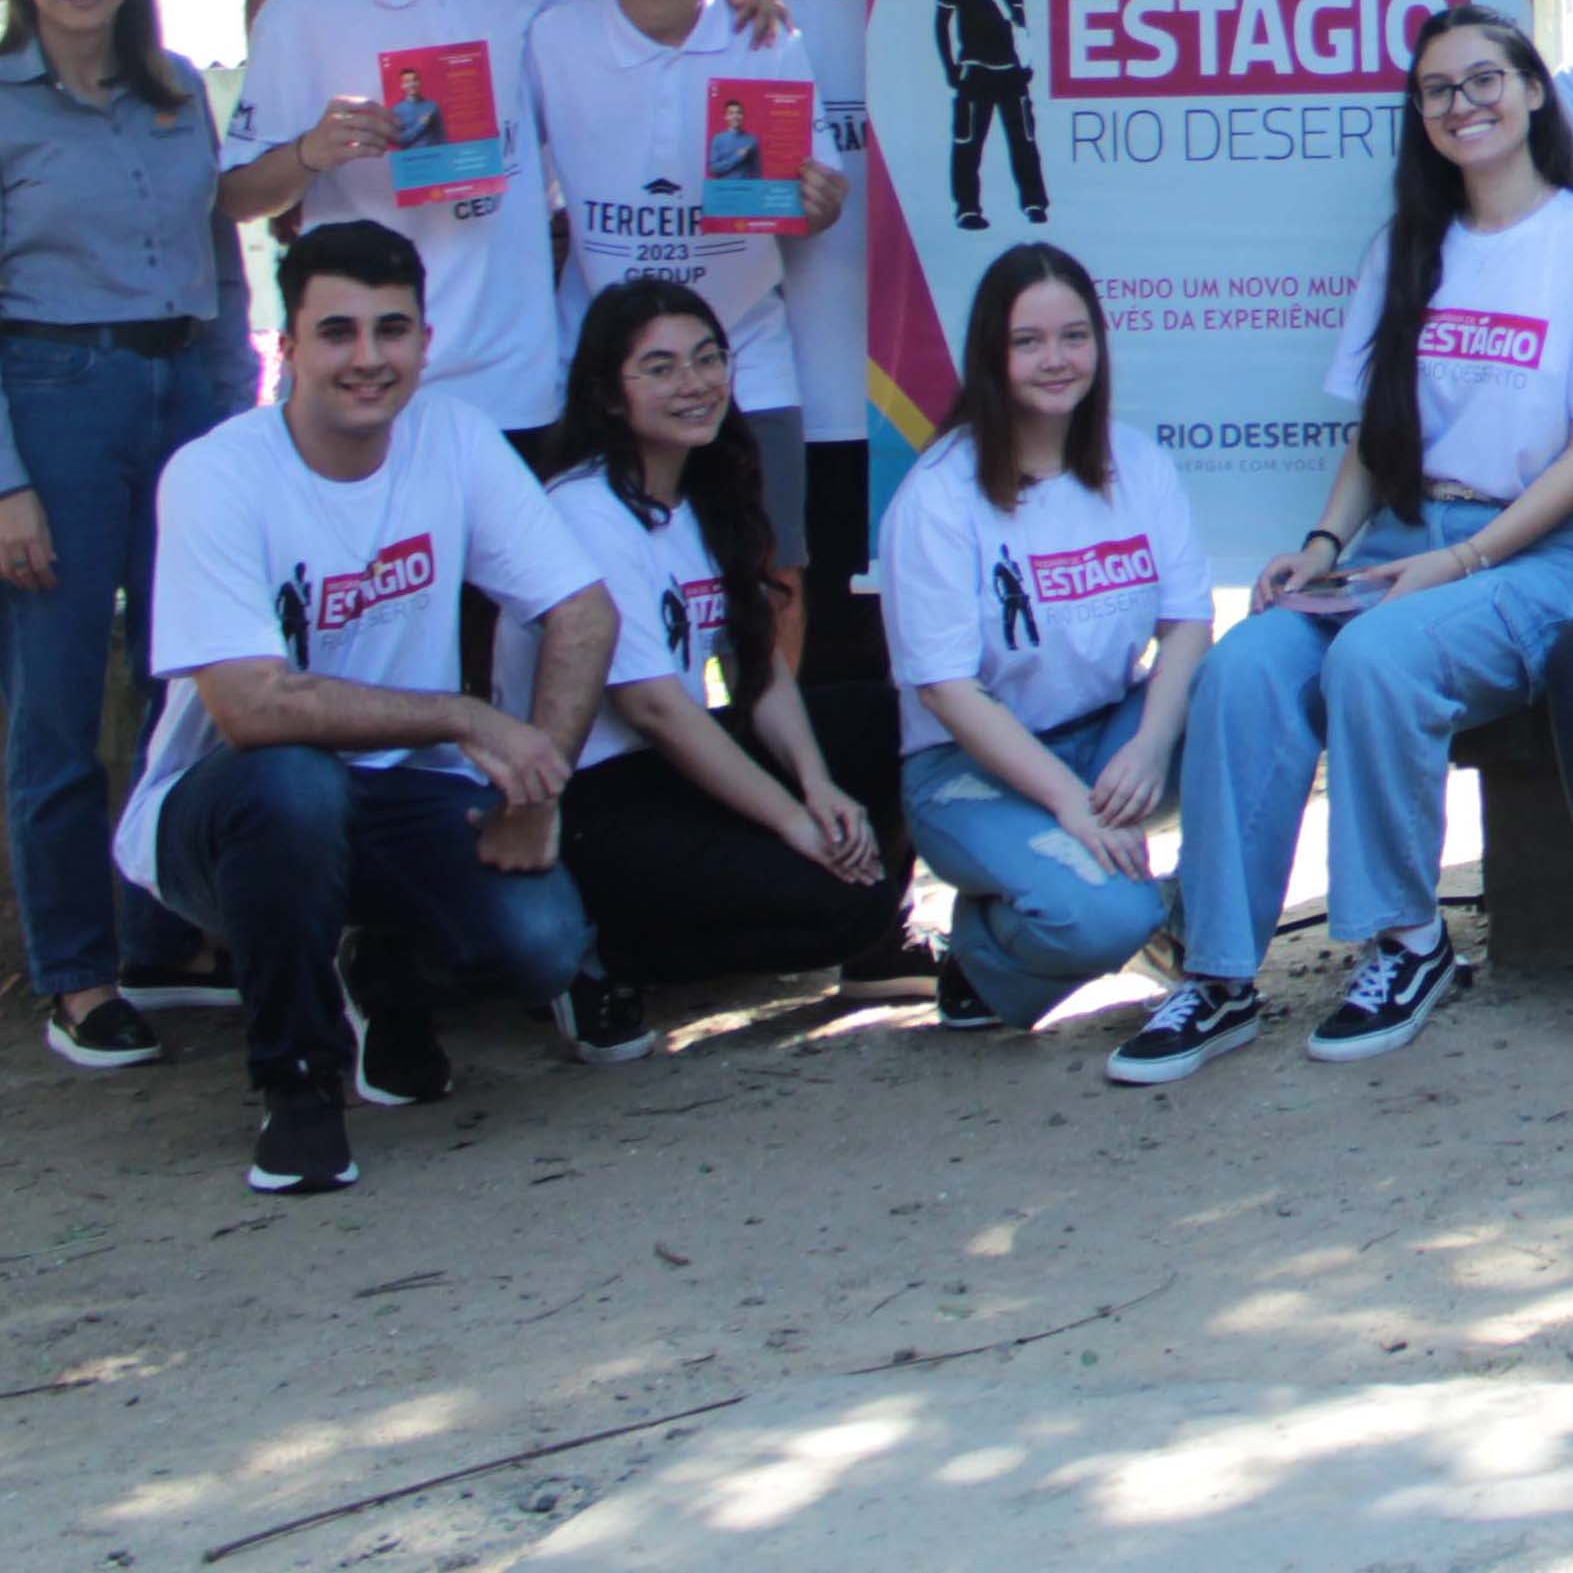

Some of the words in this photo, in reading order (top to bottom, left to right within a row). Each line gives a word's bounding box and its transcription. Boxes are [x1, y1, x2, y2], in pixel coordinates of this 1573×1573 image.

[1071, 110, 1164, 164] RIO
[1184, 105, 1404, 162] DESERT
[584, 200, 704, 237] TERCEIR
[636, 244, 690, 261] 2023
[1095, 278, 1173, 300] CENDO
[1182, 277, 1220, 299] UM
[1229, 276, 1300, 298] NOVO
[1307, 276, 1359, 298] MUN
[1163, 309, 1195, 332] DA
[1203, 303, 1344, 331] EXPERIÊNCI
[1418, 316, 1538, 362] ESTÁGIO
[1156, 423, 1214, 448] RIO
[1036, 547, 1154, 598] ESTÁGIO
